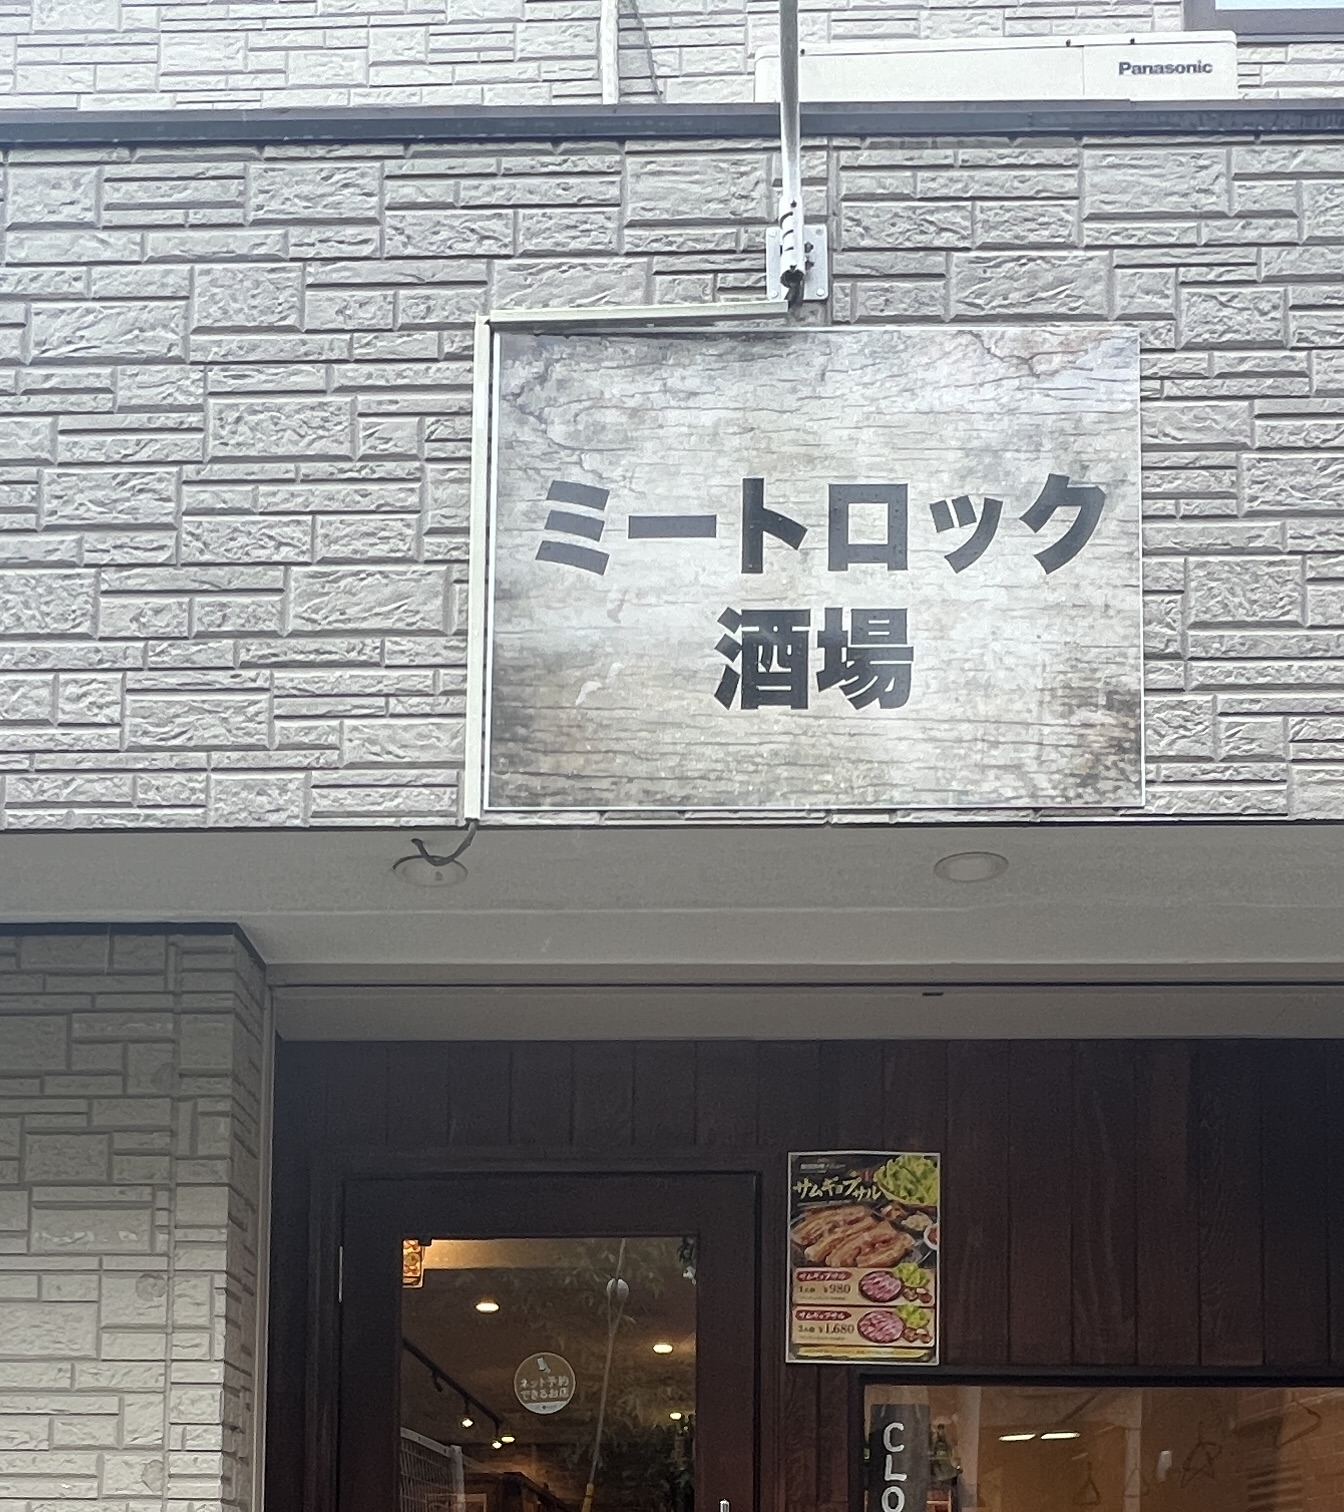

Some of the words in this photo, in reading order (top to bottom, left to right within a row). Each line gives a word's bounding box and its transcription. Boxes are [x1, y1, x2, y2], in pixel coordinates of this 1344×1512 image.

[1118, 60, 1214, 75] Panasonic
[535, 473, 1107, 576] ミートロック
[713, 606, 914, 711] 酒場
